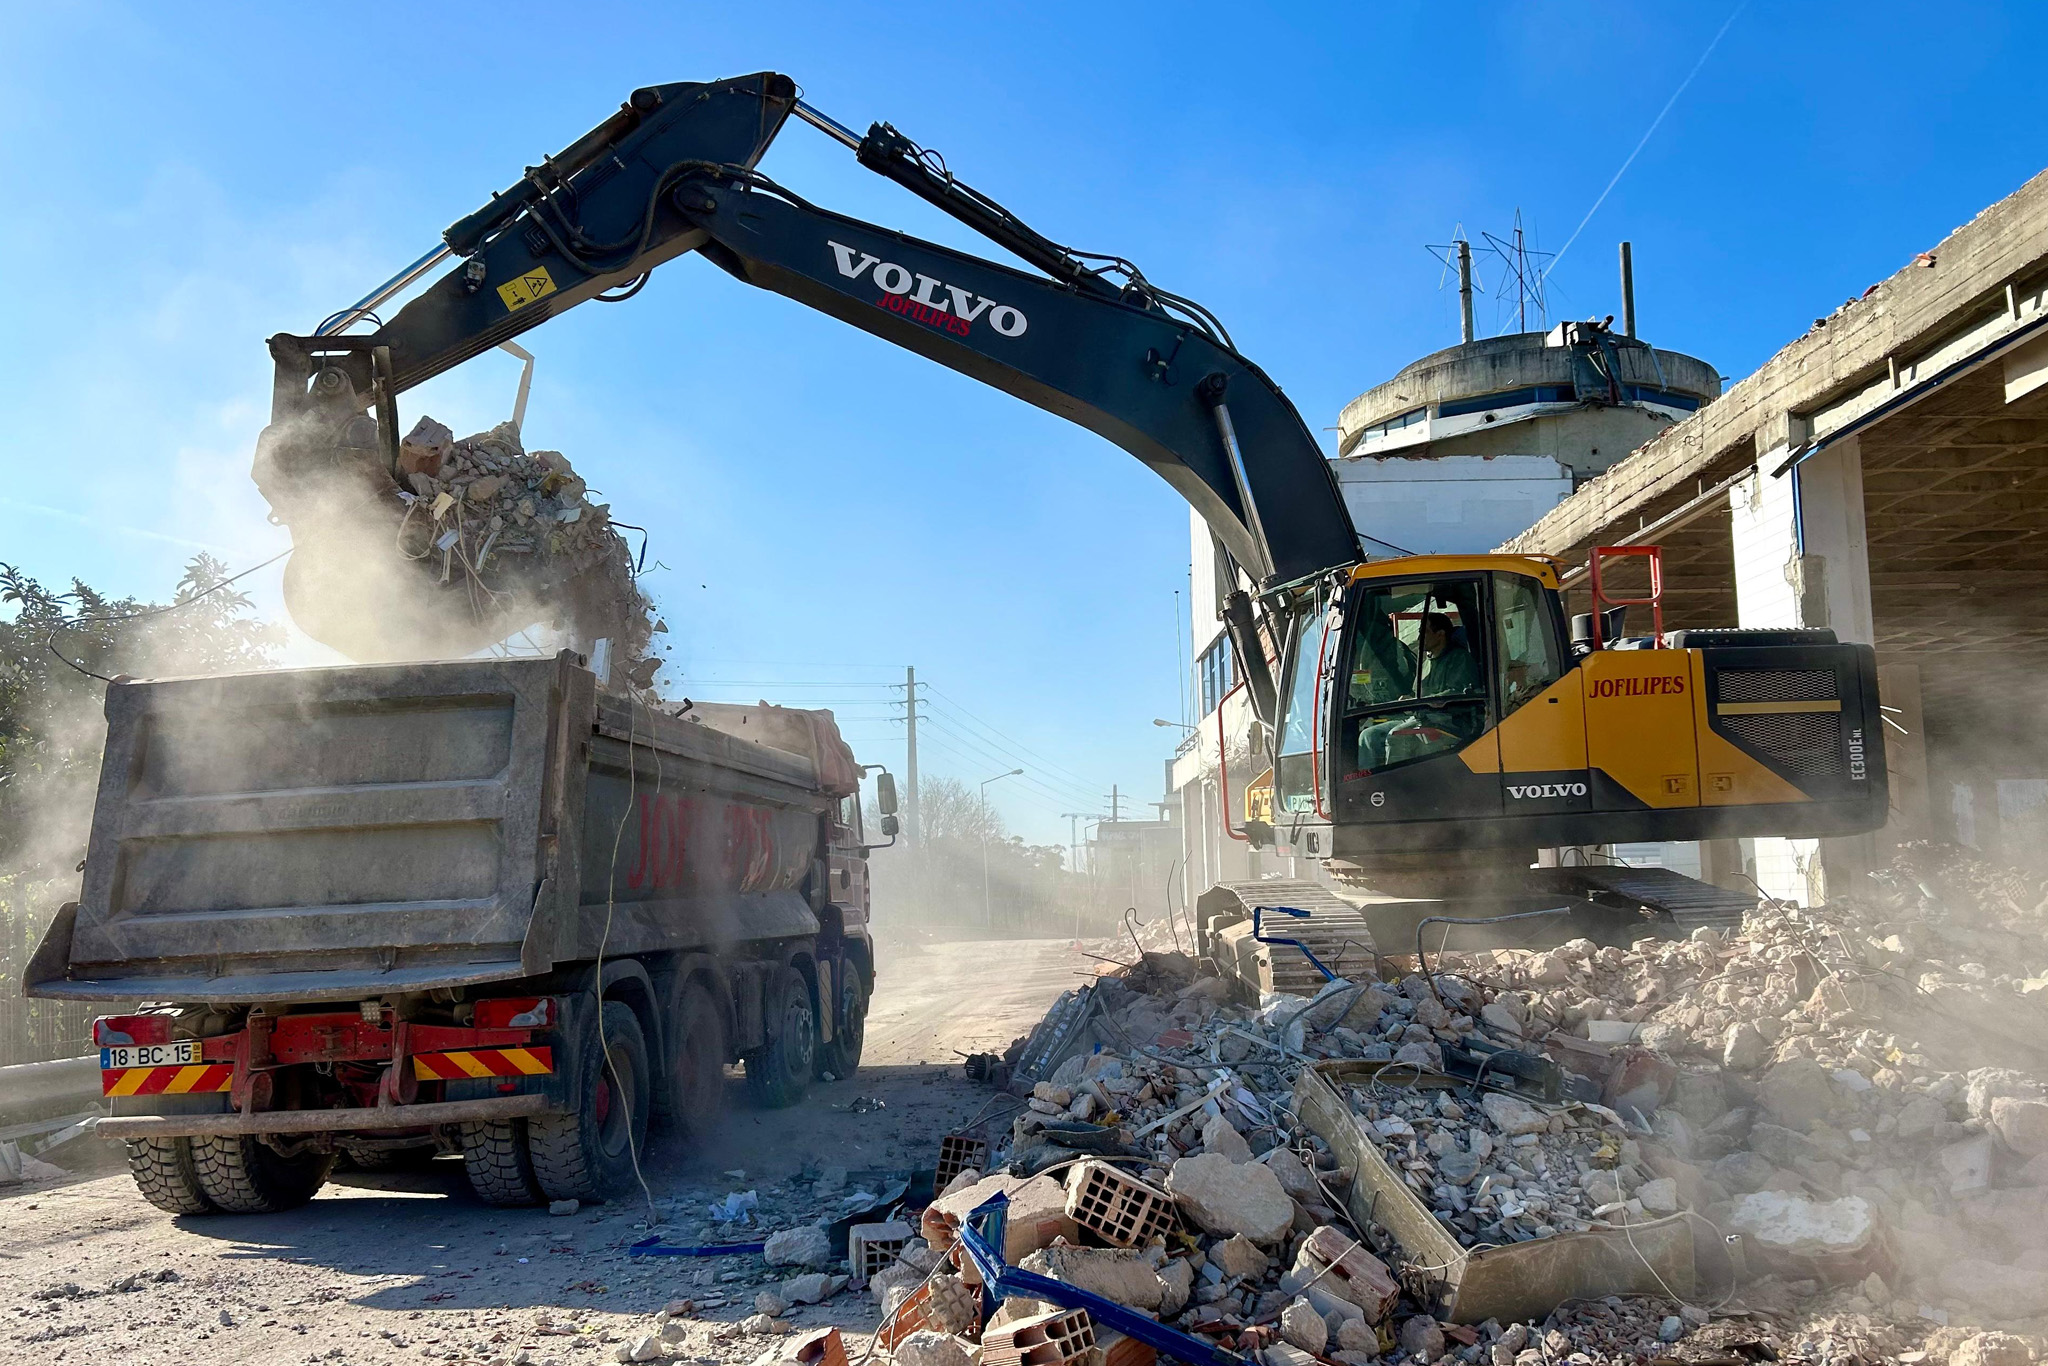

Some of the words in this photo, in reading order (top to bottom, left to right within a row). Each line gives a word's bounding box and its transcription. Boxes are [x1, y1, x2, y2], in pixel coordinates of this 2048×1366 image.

[827, 240, 1028, 337] VOLVO
[875, 291, 971, 337] JOFILIPES
[1589, 675, 1685, 699] JOFILIPES
[1506, 783, 1587, 799] VOLVO
